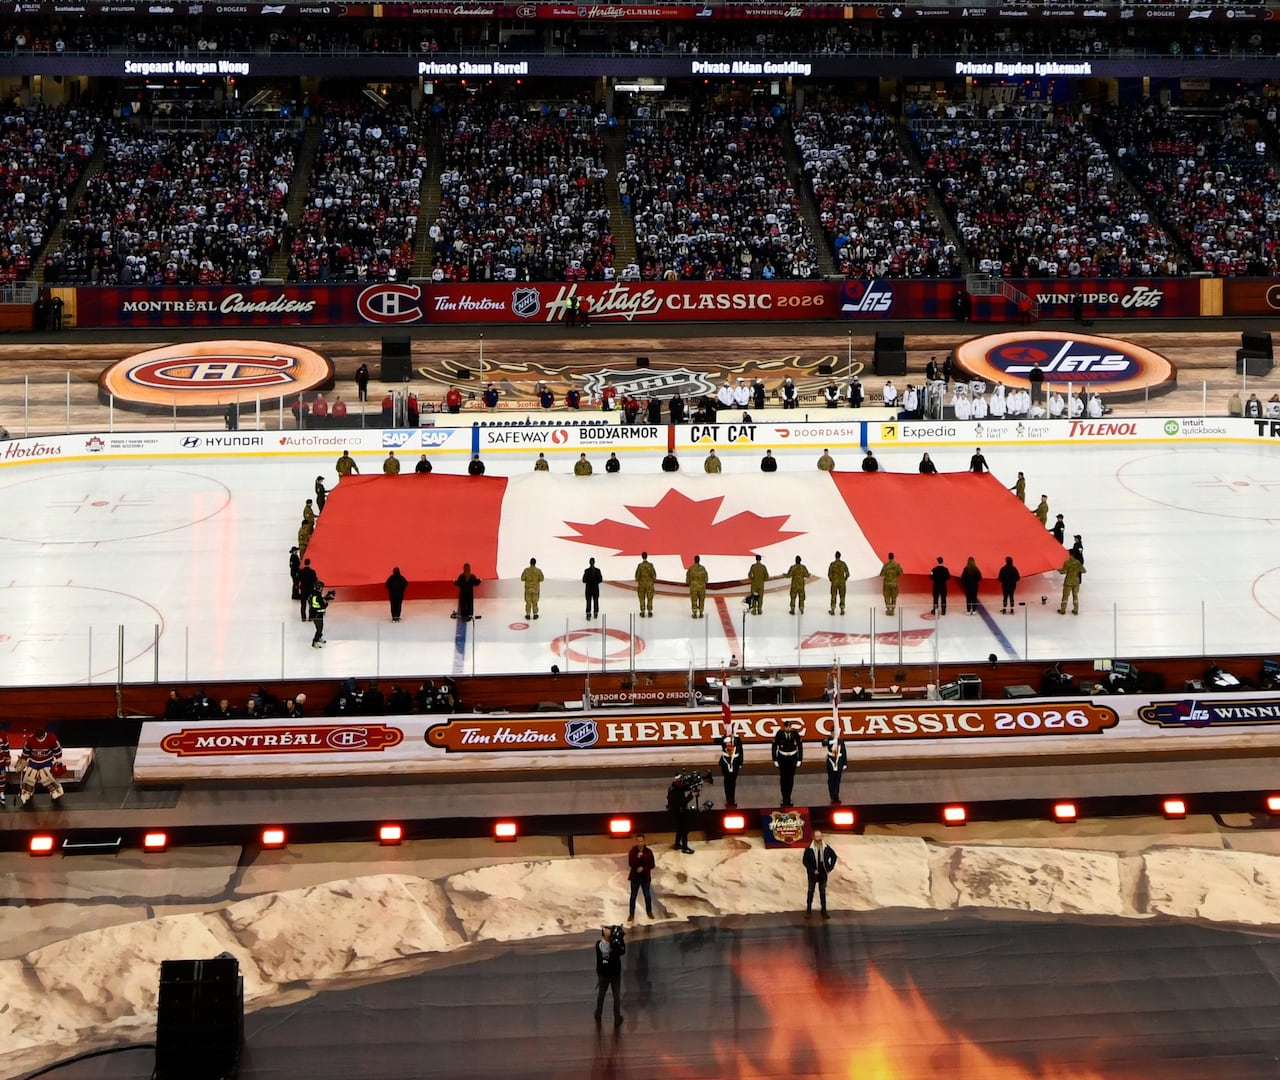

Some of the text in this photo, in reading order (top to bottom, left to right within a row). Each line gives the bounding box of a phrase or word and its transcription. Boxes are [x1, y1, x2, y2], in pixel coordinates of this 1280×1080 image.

[626, 8, 662, 16] CLASSIC
[124, 61, 249, 77] Sergeant Morgan Wong
[418, 61, 528, 75] Private Shaun Farrell
[691, 61, 812, 77] Private Aidan Goulding
[955, 61, 1092, 77] Private Hayden Lykkemark
[122, 292, 317, 314] MONTRÉAL Canadiens
[433, 295, 506, 311] Tim Hortons
[517, 294, 536, 314] NHL
[546, 282, 663, 322] Hritage
[666, 293, 825, 310] CLASSIC 2026
[841, 280, 892, 312] JETS
[1121, 286, 1165, 309] Jets
[1004, 340, 1130, 373] JETS
[616, 375, 686, 394] NHL
[383, 431, 408, 444] SAP
[422, 431, 448, 444] SAP
[487, 431, 550, 444] SAFEWAY
[579, 427, 658, 440] BODYARMOR
[690, 425, 720, 443] CAT
[727, 425, 757, 443] CAT
[794, 429, 854, 438] DOORDASH
[903, 426, 956, 438] Expedia
[1069, 421, 1138, 438] TYLENOL
[1182, 427, 1227, 436] quickbooks
[205, 437, 264, 446] HYUNDAI
[286, 436, 362, 446] AutoTrader.ca
[5, 442, 62, 460] Hortons
[1179, 699, 1210, 721] JETS
[572, 722, 594, 742] NHL
[605, 709, 1090, 742] HERITAGE CLASSIC 2026
[194, 731, 322, 748] MONTRÉAL
[459, 727, 558, 745] Tim Hortons
